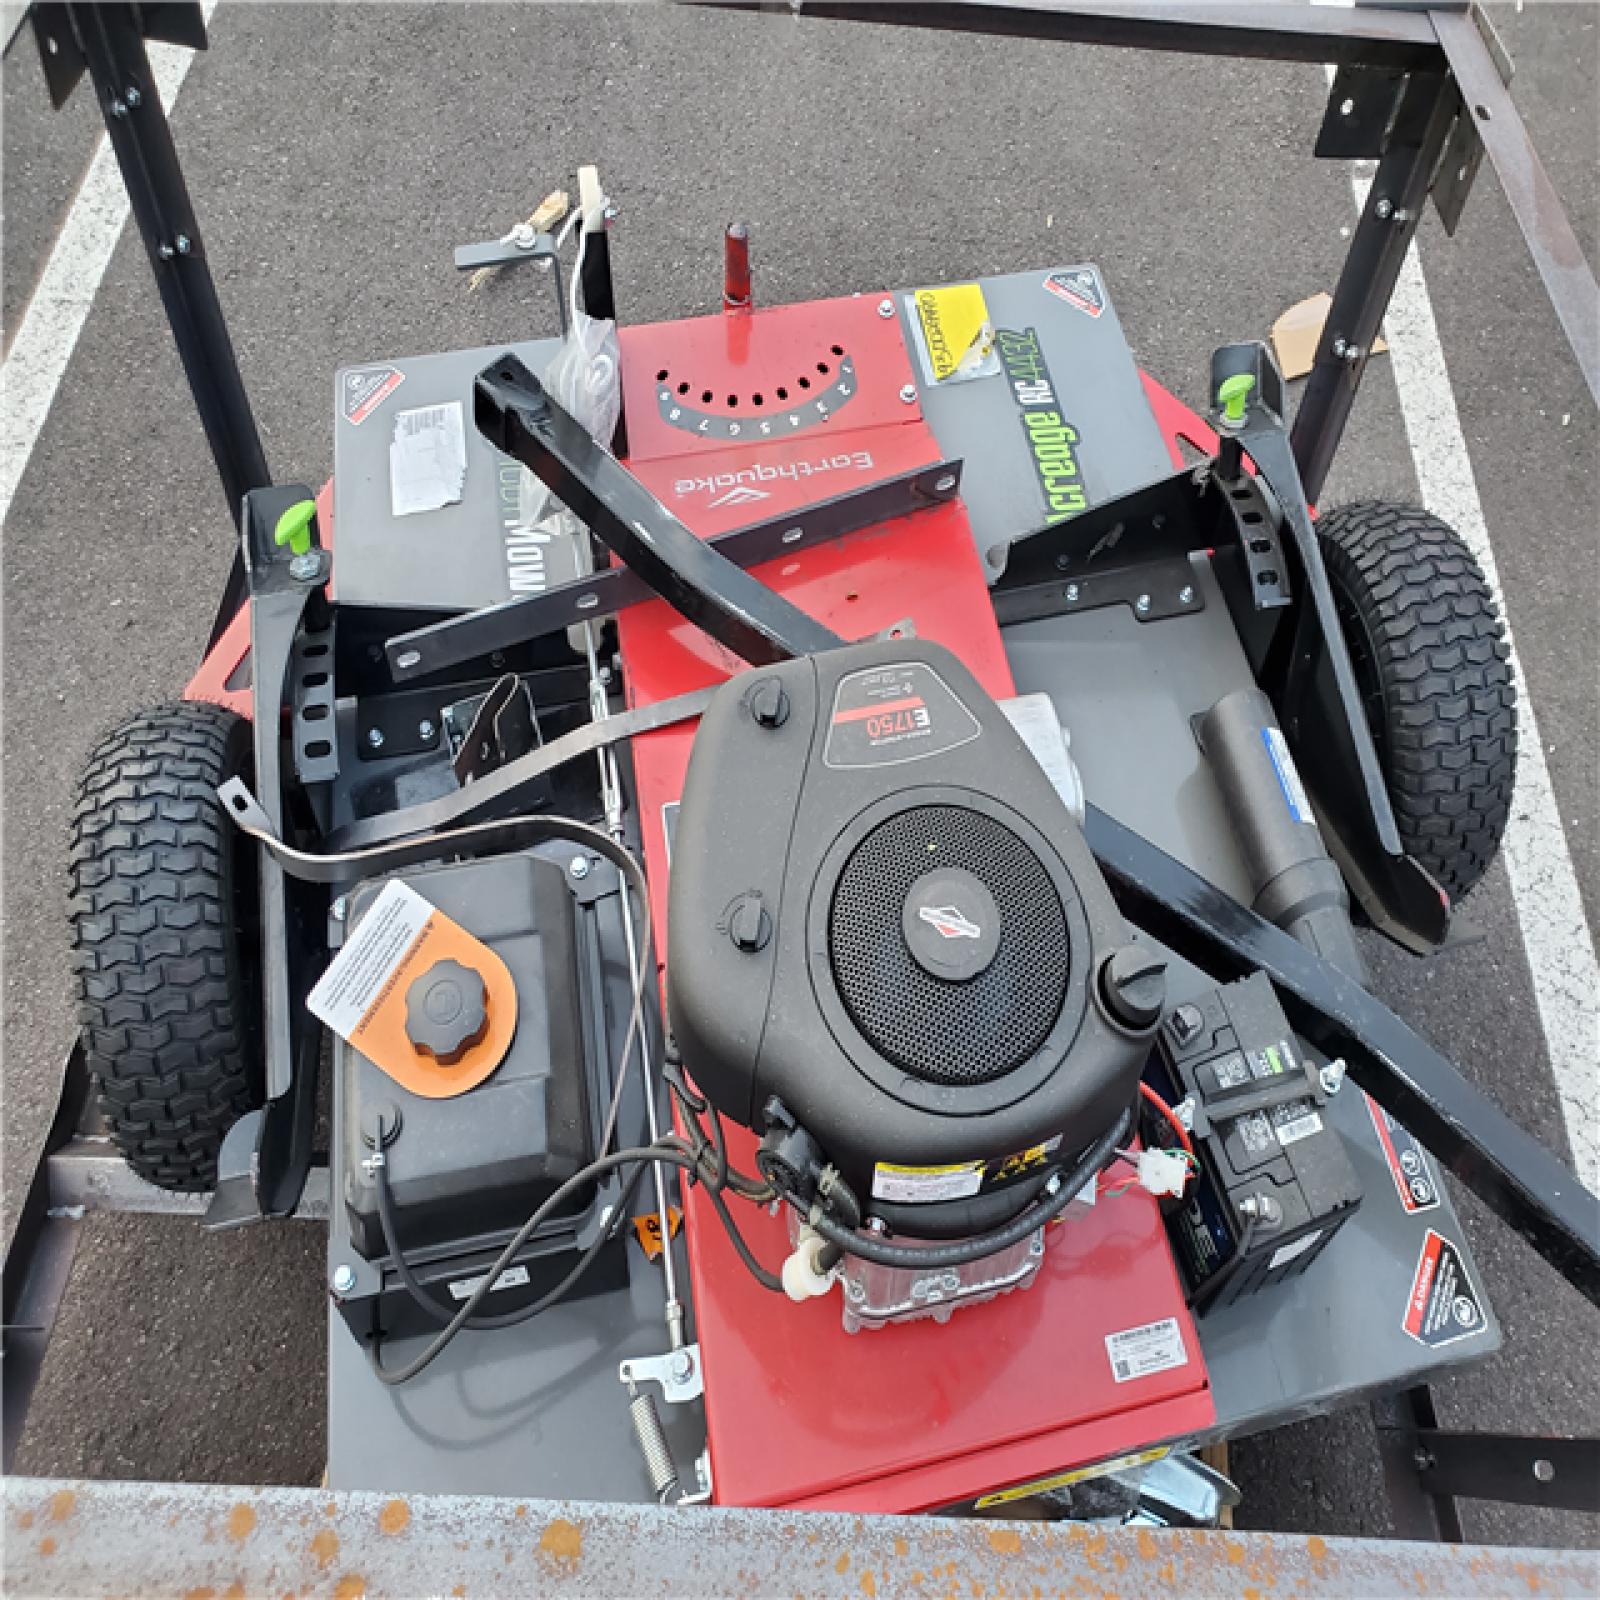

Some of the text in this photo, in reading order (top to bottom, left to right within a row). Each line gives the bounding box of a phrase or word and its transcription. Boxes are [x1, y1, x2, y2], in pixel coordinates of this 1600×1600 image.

[837, 383, 851, 396] 2
[669, 408, 681, 421] 8
[789, 414, 800, 426] 4
[699, 419, 710, 431] 7
[729, 422, 741, 435] 6
[759, 421, 771, 434] 5
[674, 451, 874, 496] Earthquake
[866, 707, 931, 738] E1750
